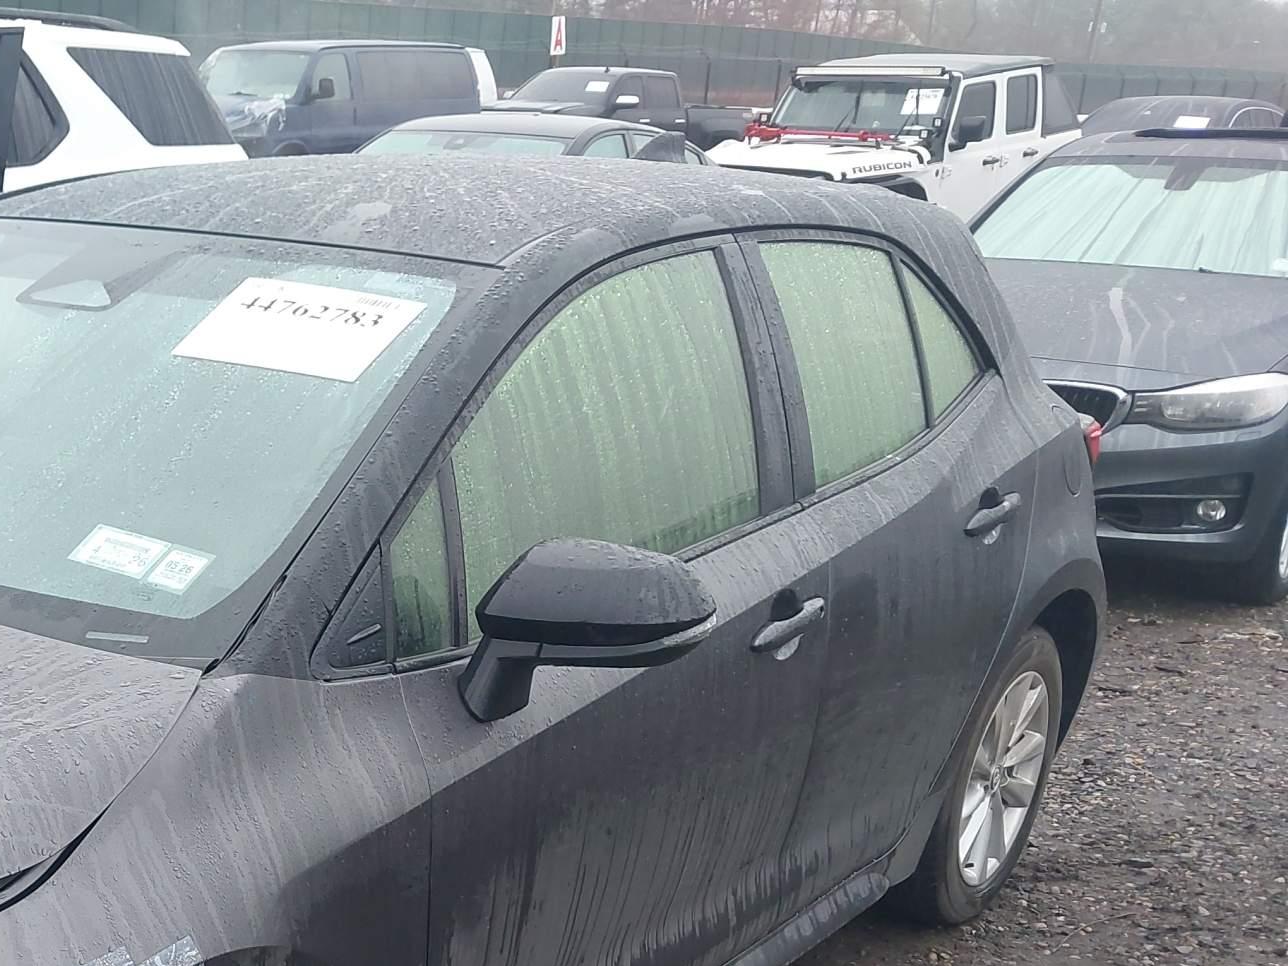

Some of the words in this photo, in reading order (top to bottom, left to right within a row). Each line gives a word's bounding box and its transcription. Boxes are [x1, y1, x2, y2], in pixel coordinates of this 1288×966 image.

[553, 17, 564, 52] A
[852, 161, 912, 175] RUBICON
[241, 296, 384, 327] 44762783
